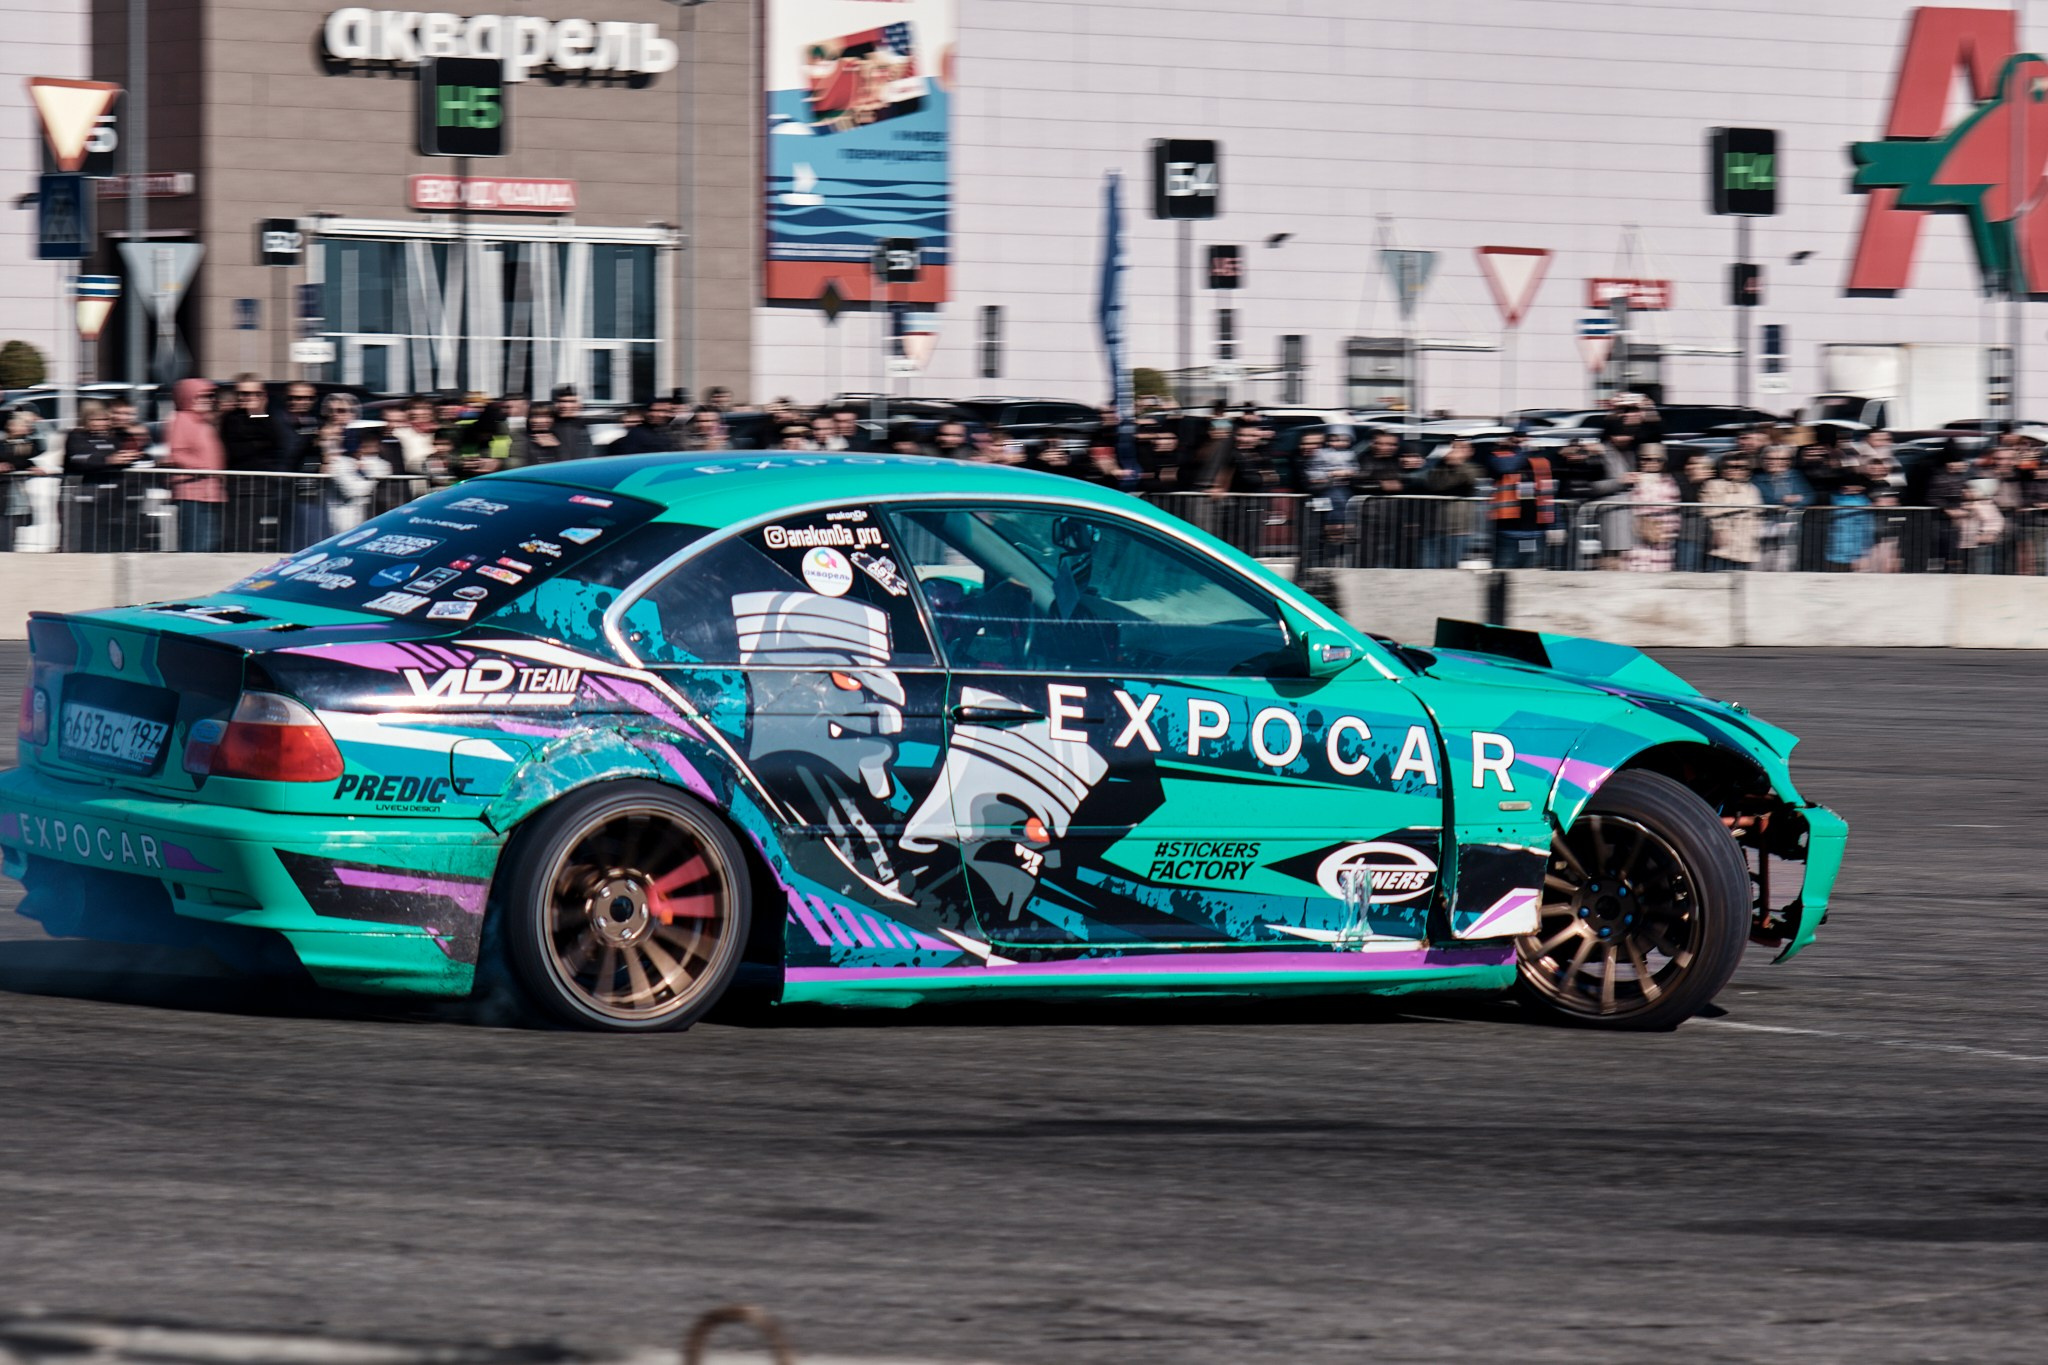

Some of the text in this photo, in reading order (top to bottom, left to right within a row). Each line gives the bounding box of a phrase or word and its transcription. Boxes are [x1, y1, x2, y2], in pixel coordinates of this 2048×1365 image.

[324, 7, 680, 83] акварель
[804, 569, 850, 580] акварель
[518, 668, 580, 692] TEAM
[131, 719, 163, 751] 197
[1046, 682, 1517, 792] EXPOCAR
[128, 749, 145, 760] RUS
[333, 773, 474, 803] PREDICT
[19, 812, 162, 868] EXPOCAR
[1154, 841, 1261, 858] #STICKERS
[1149, 861, 1255, 880] FACTORY
